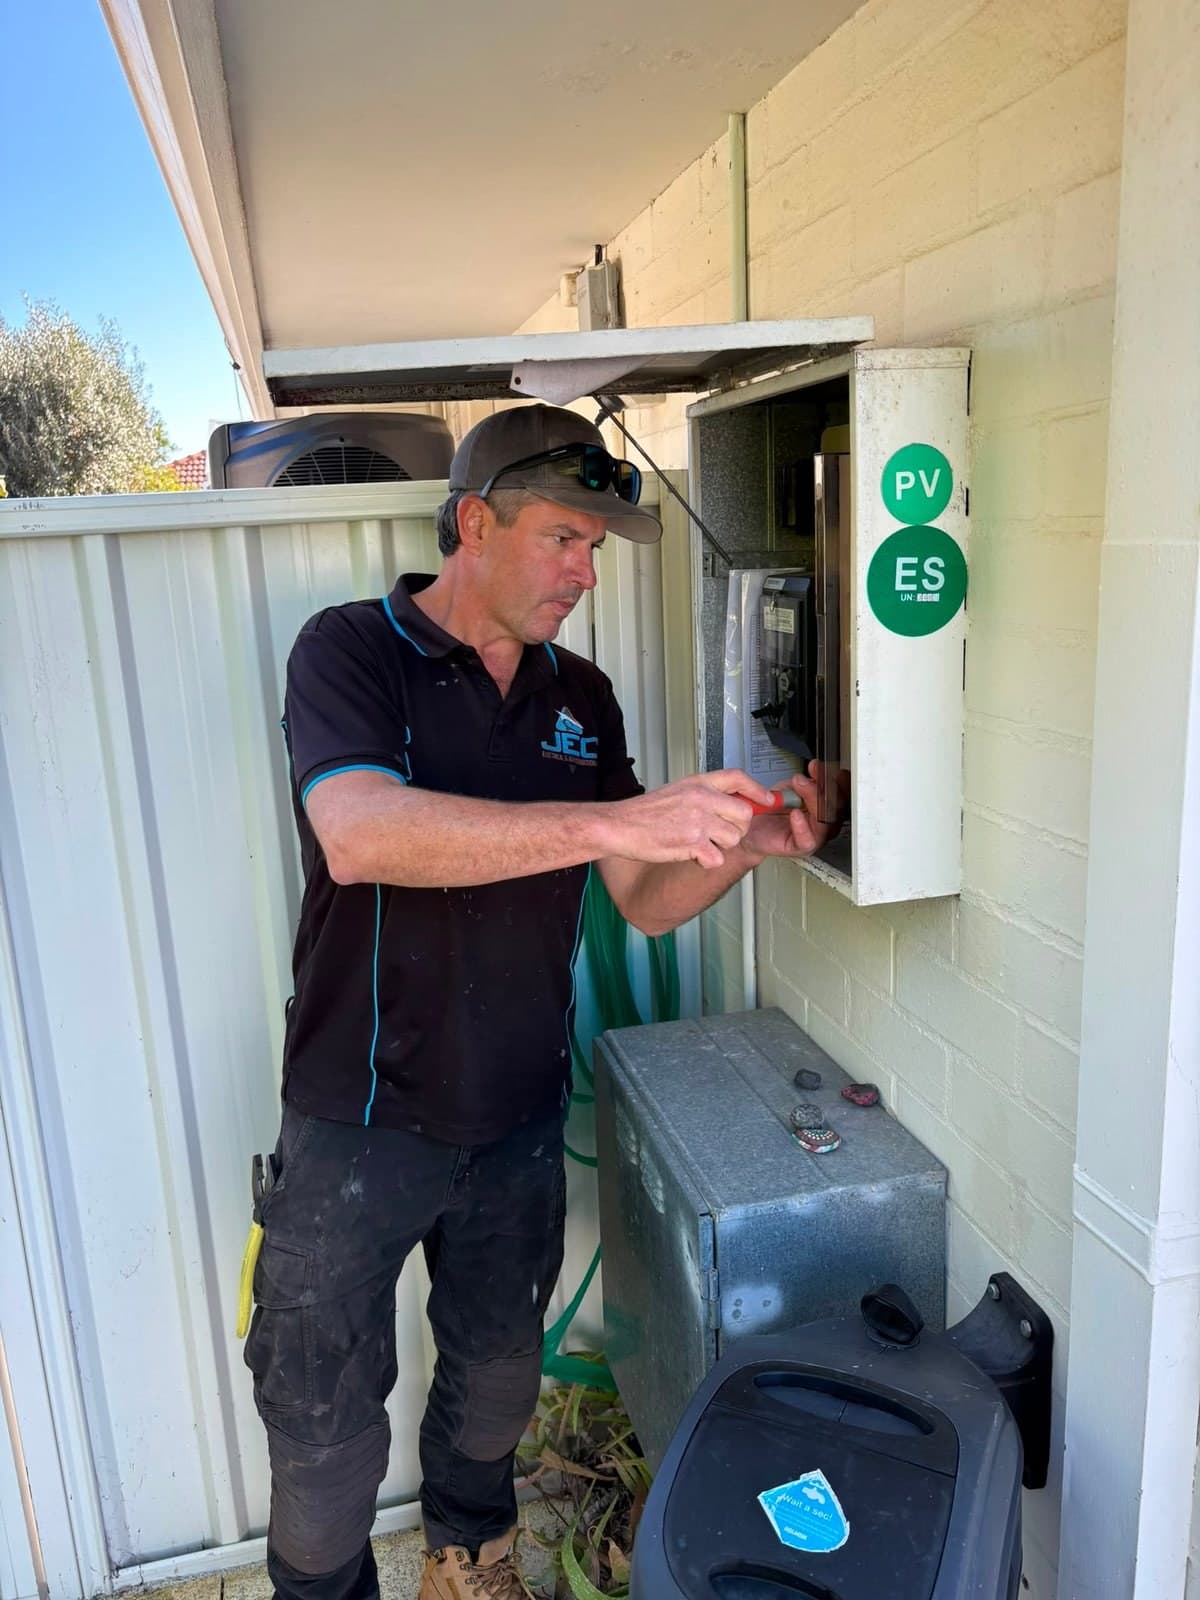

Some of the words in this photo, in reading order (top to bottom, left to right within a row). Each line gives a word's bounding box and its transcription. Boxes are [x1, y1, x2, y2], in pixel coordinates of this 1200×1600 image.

[895, 468, 941, 500] PV
[895, 556, 945, 591] ES
[540, 731, 599, 760] JEC
[782, 1493, 802, 1509] Wait
[811, 1509, 833, 1521] sec!
